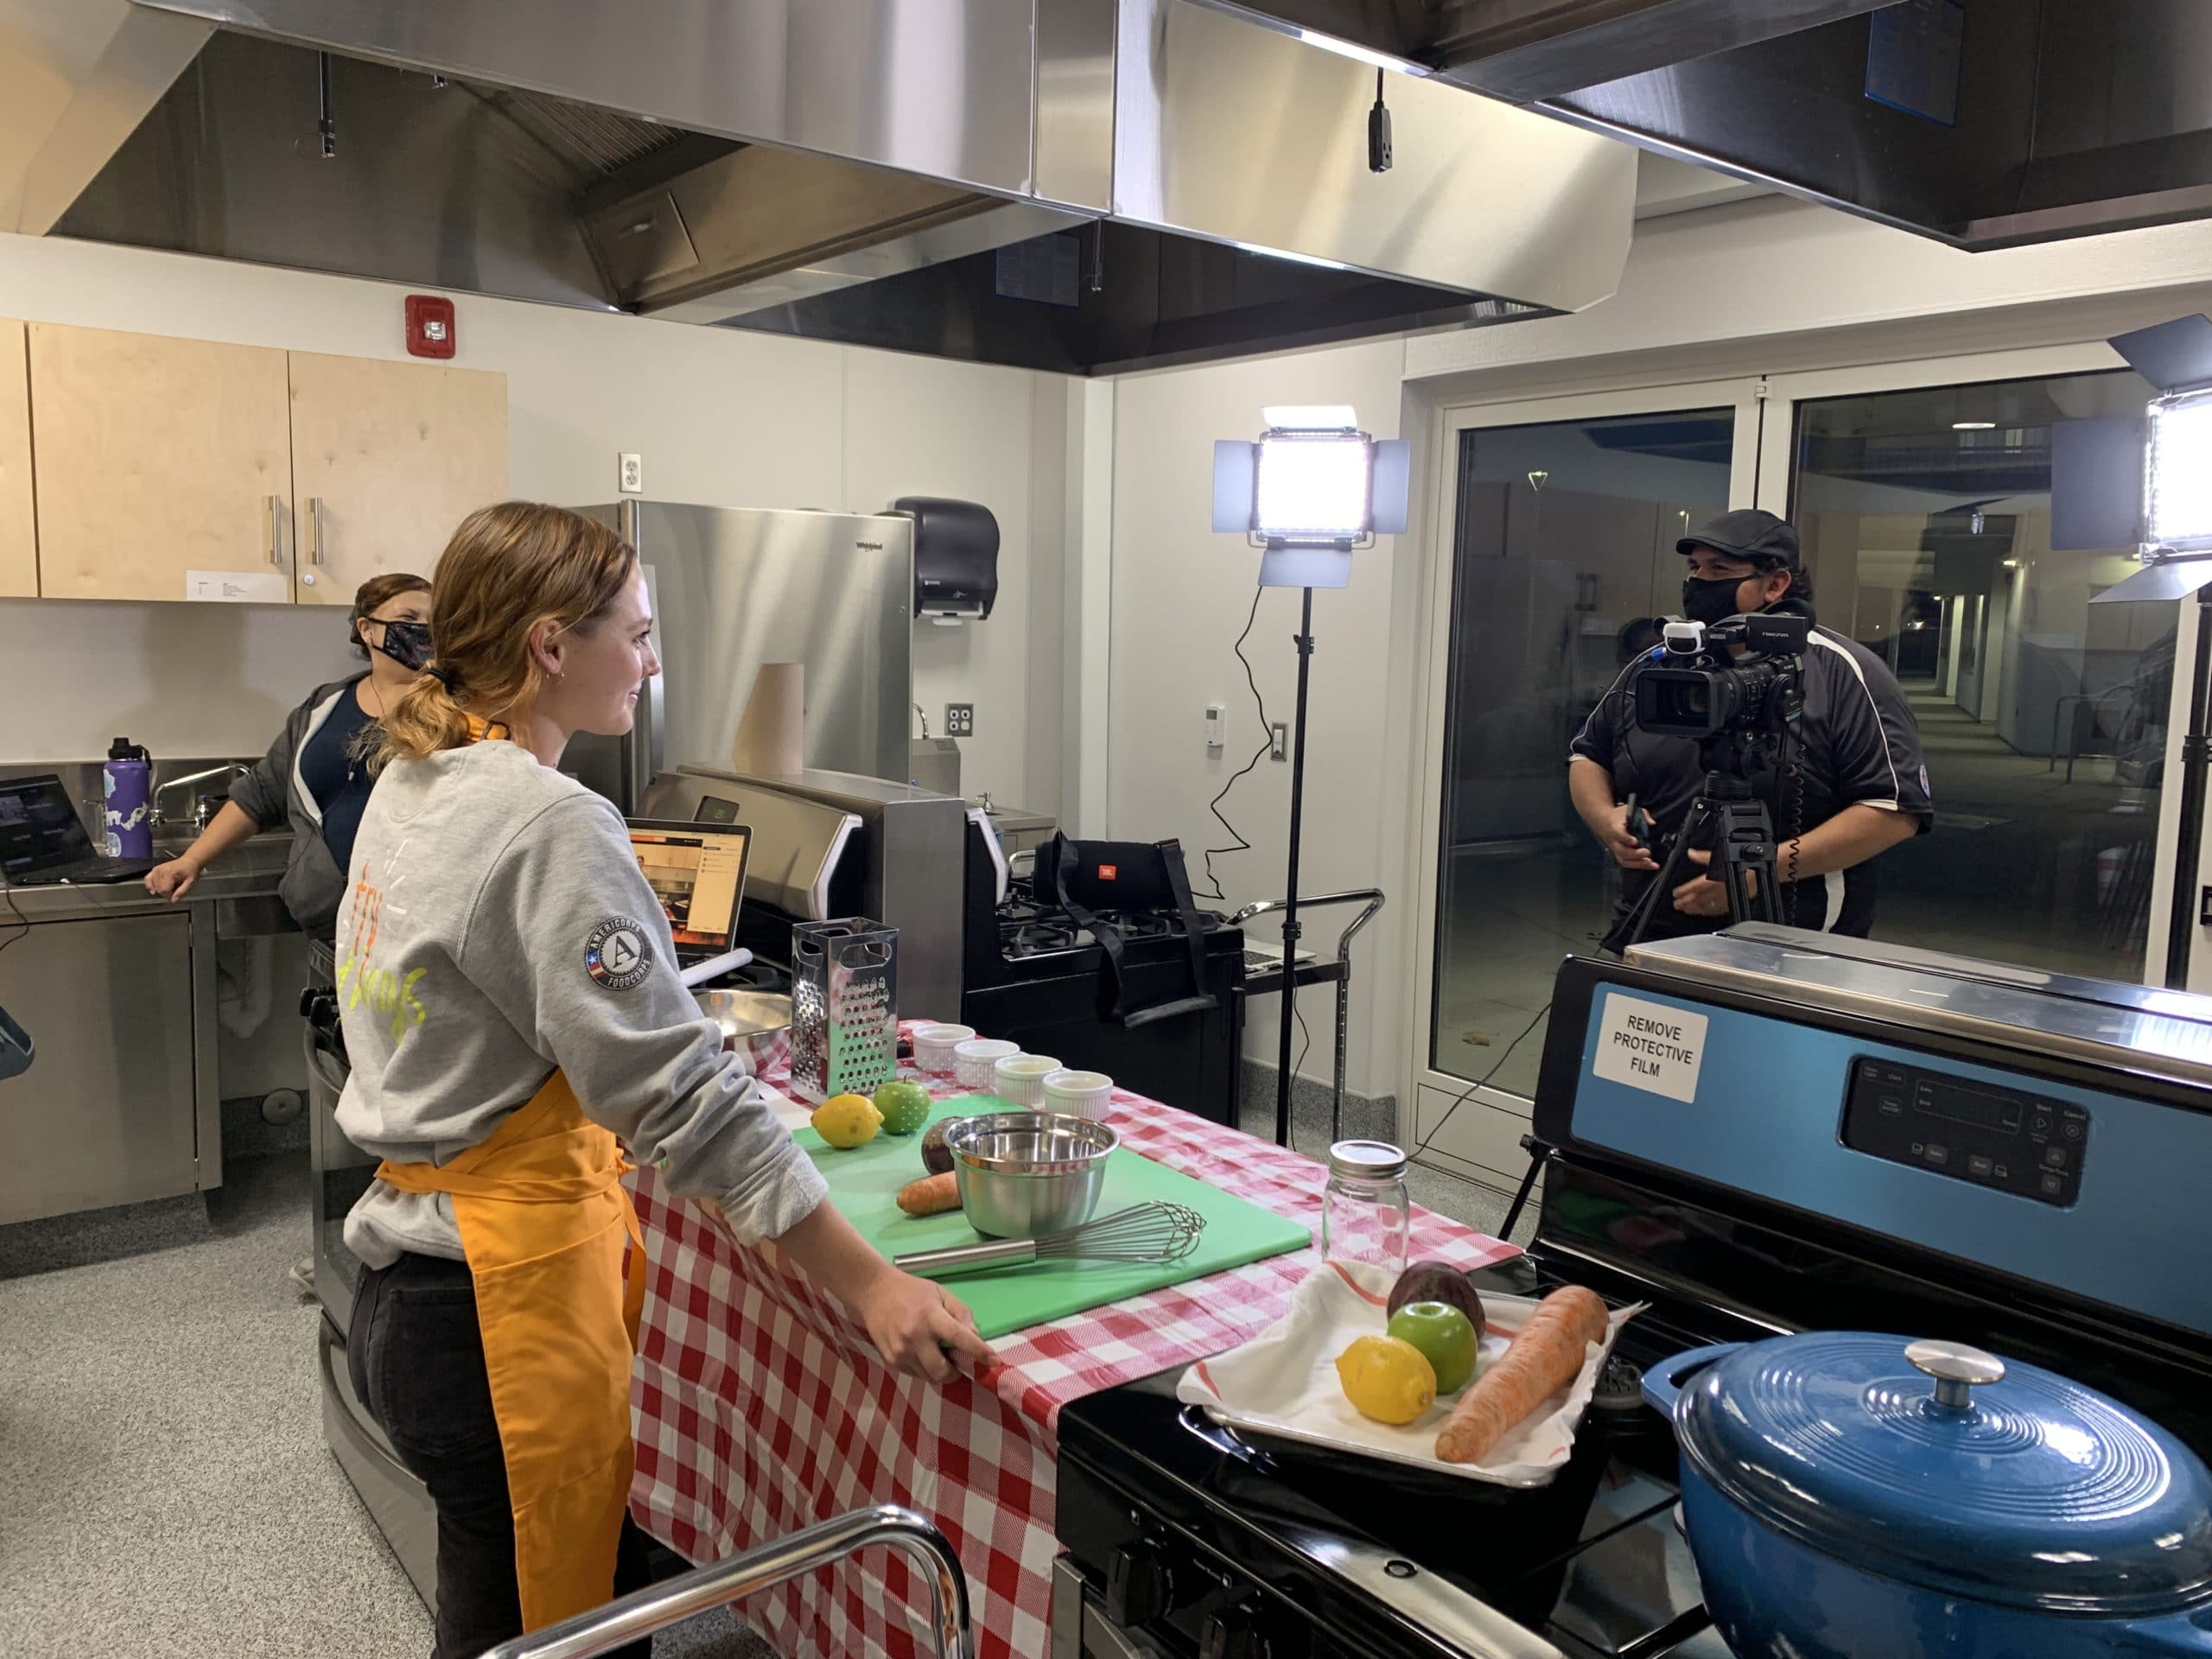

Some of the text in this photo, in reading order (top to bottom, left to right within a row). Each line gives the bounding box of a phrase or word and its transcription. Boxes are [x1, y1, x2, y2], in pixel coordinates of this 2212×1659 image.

[590, 918, 640, 949] AMERICORPS
[613, 935, 638, 968] A
[607, 959, 651, 988] FOODCORPS
[1627, 1014, 1682, 1041] REMOVE
[1613, 1031, 1694, 1065] PROTECTIVE
[1630, 1057, 1661, 1077] FILM
